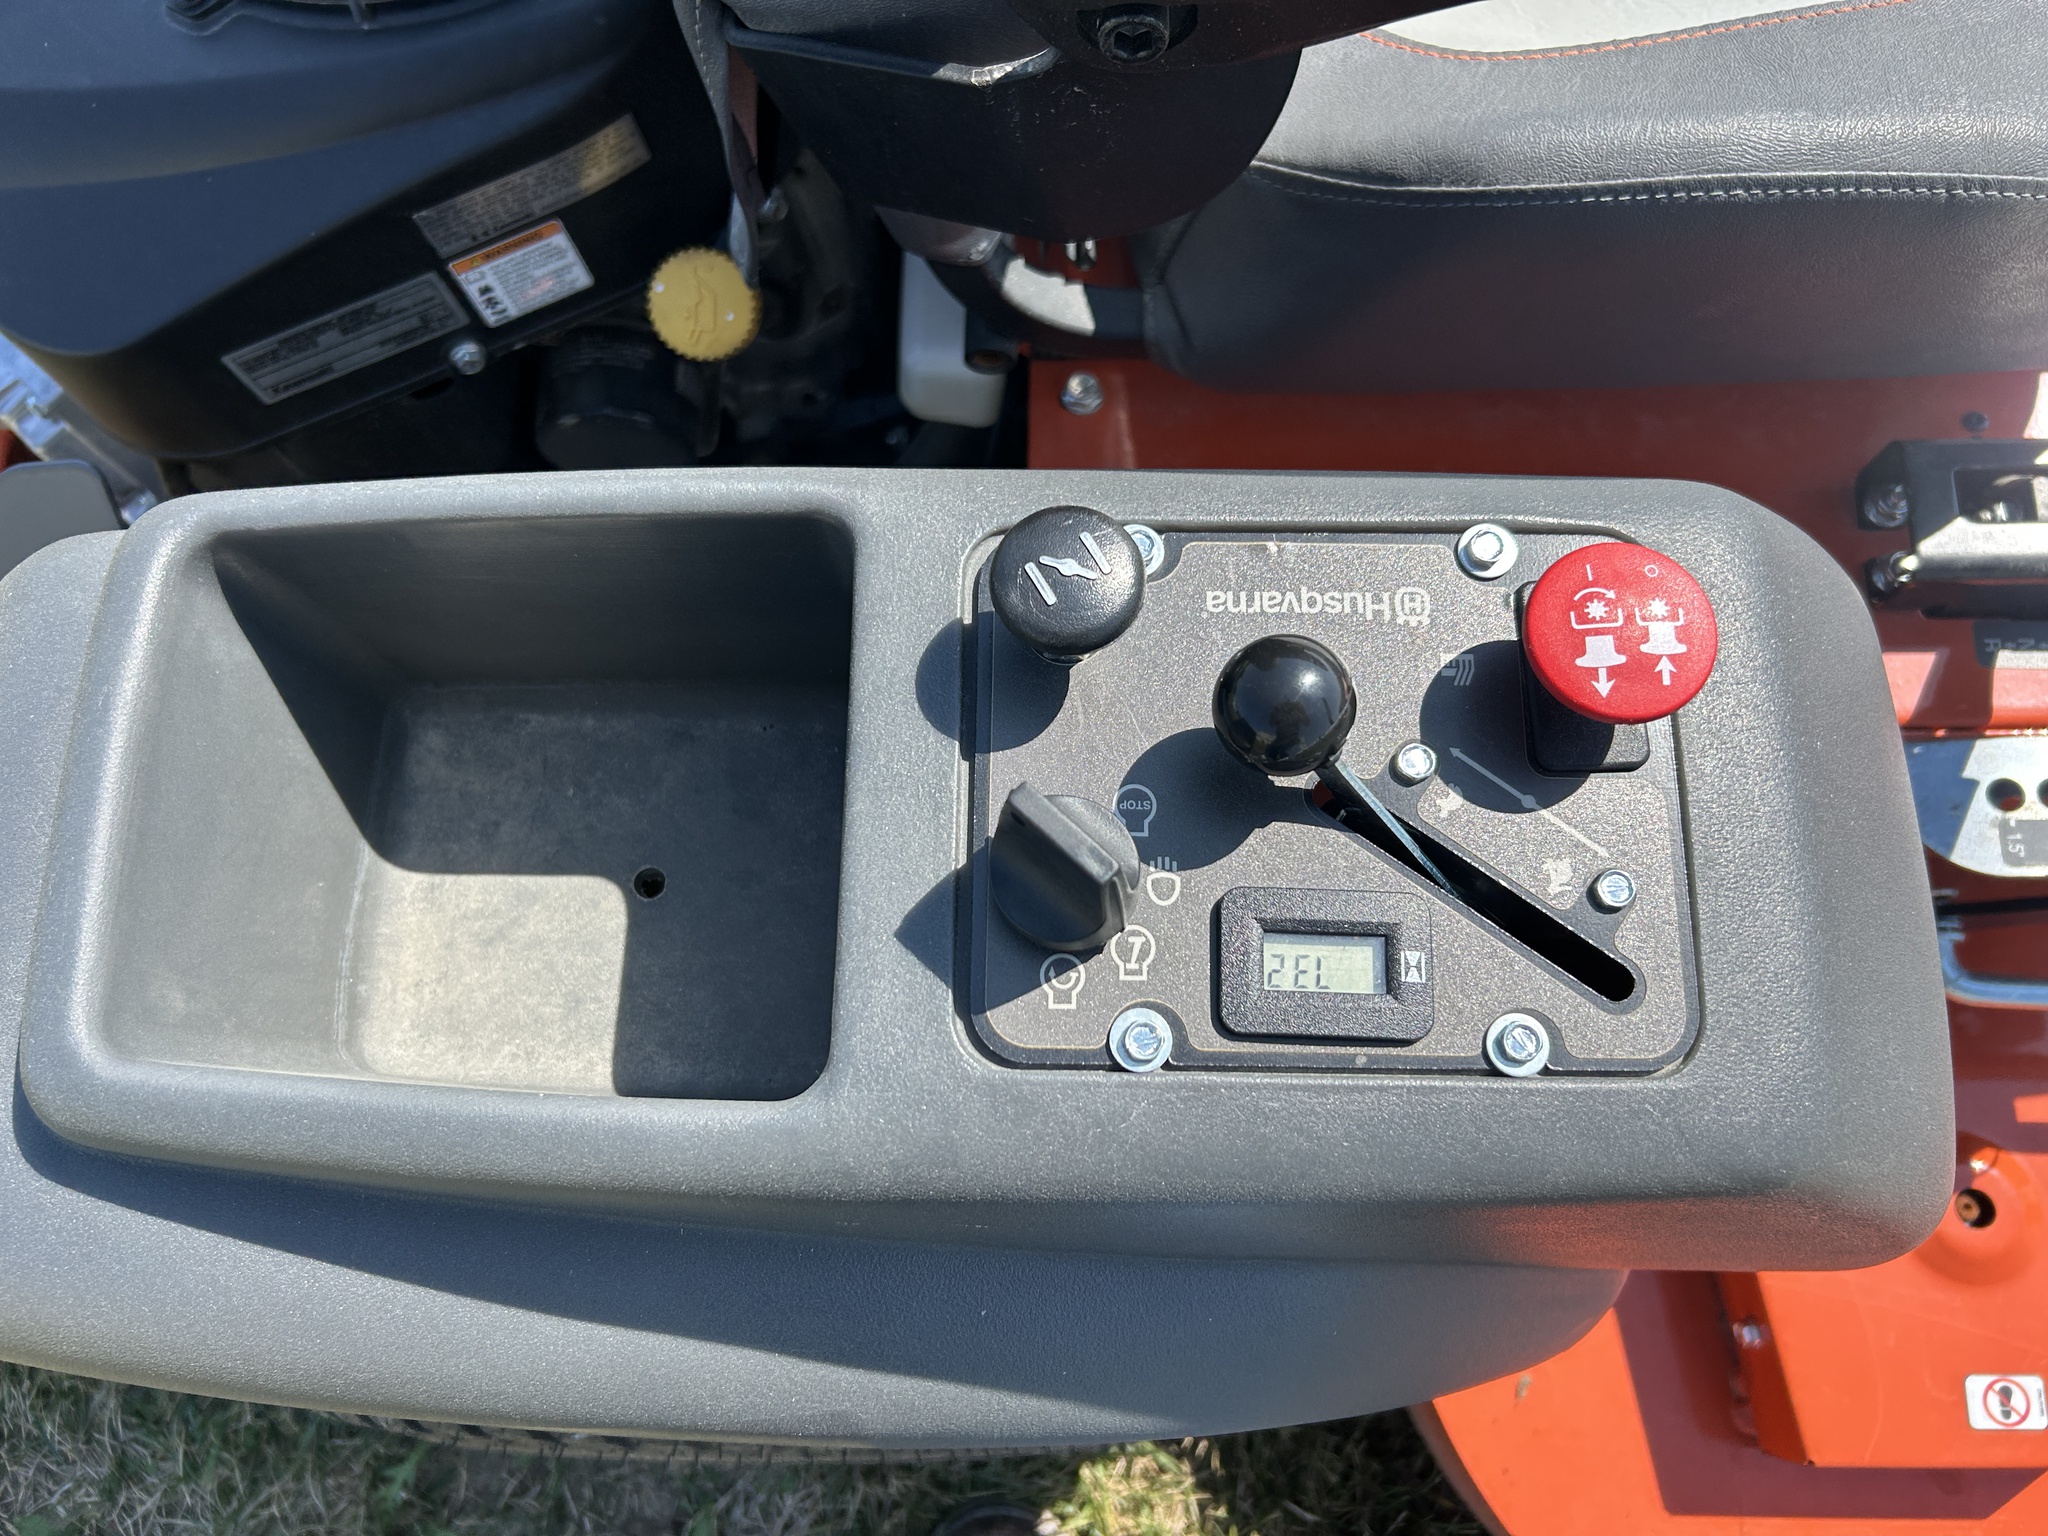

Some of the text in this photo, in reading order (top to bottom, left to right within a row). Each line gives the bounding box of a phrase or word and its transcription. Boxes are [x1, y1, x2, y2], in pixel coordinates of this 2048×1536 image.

[1205, 586, 1391, 623] Husqvarna
[1119, 799, 1152, 810] STOP
[1267, 953, 1332, 990] 732
